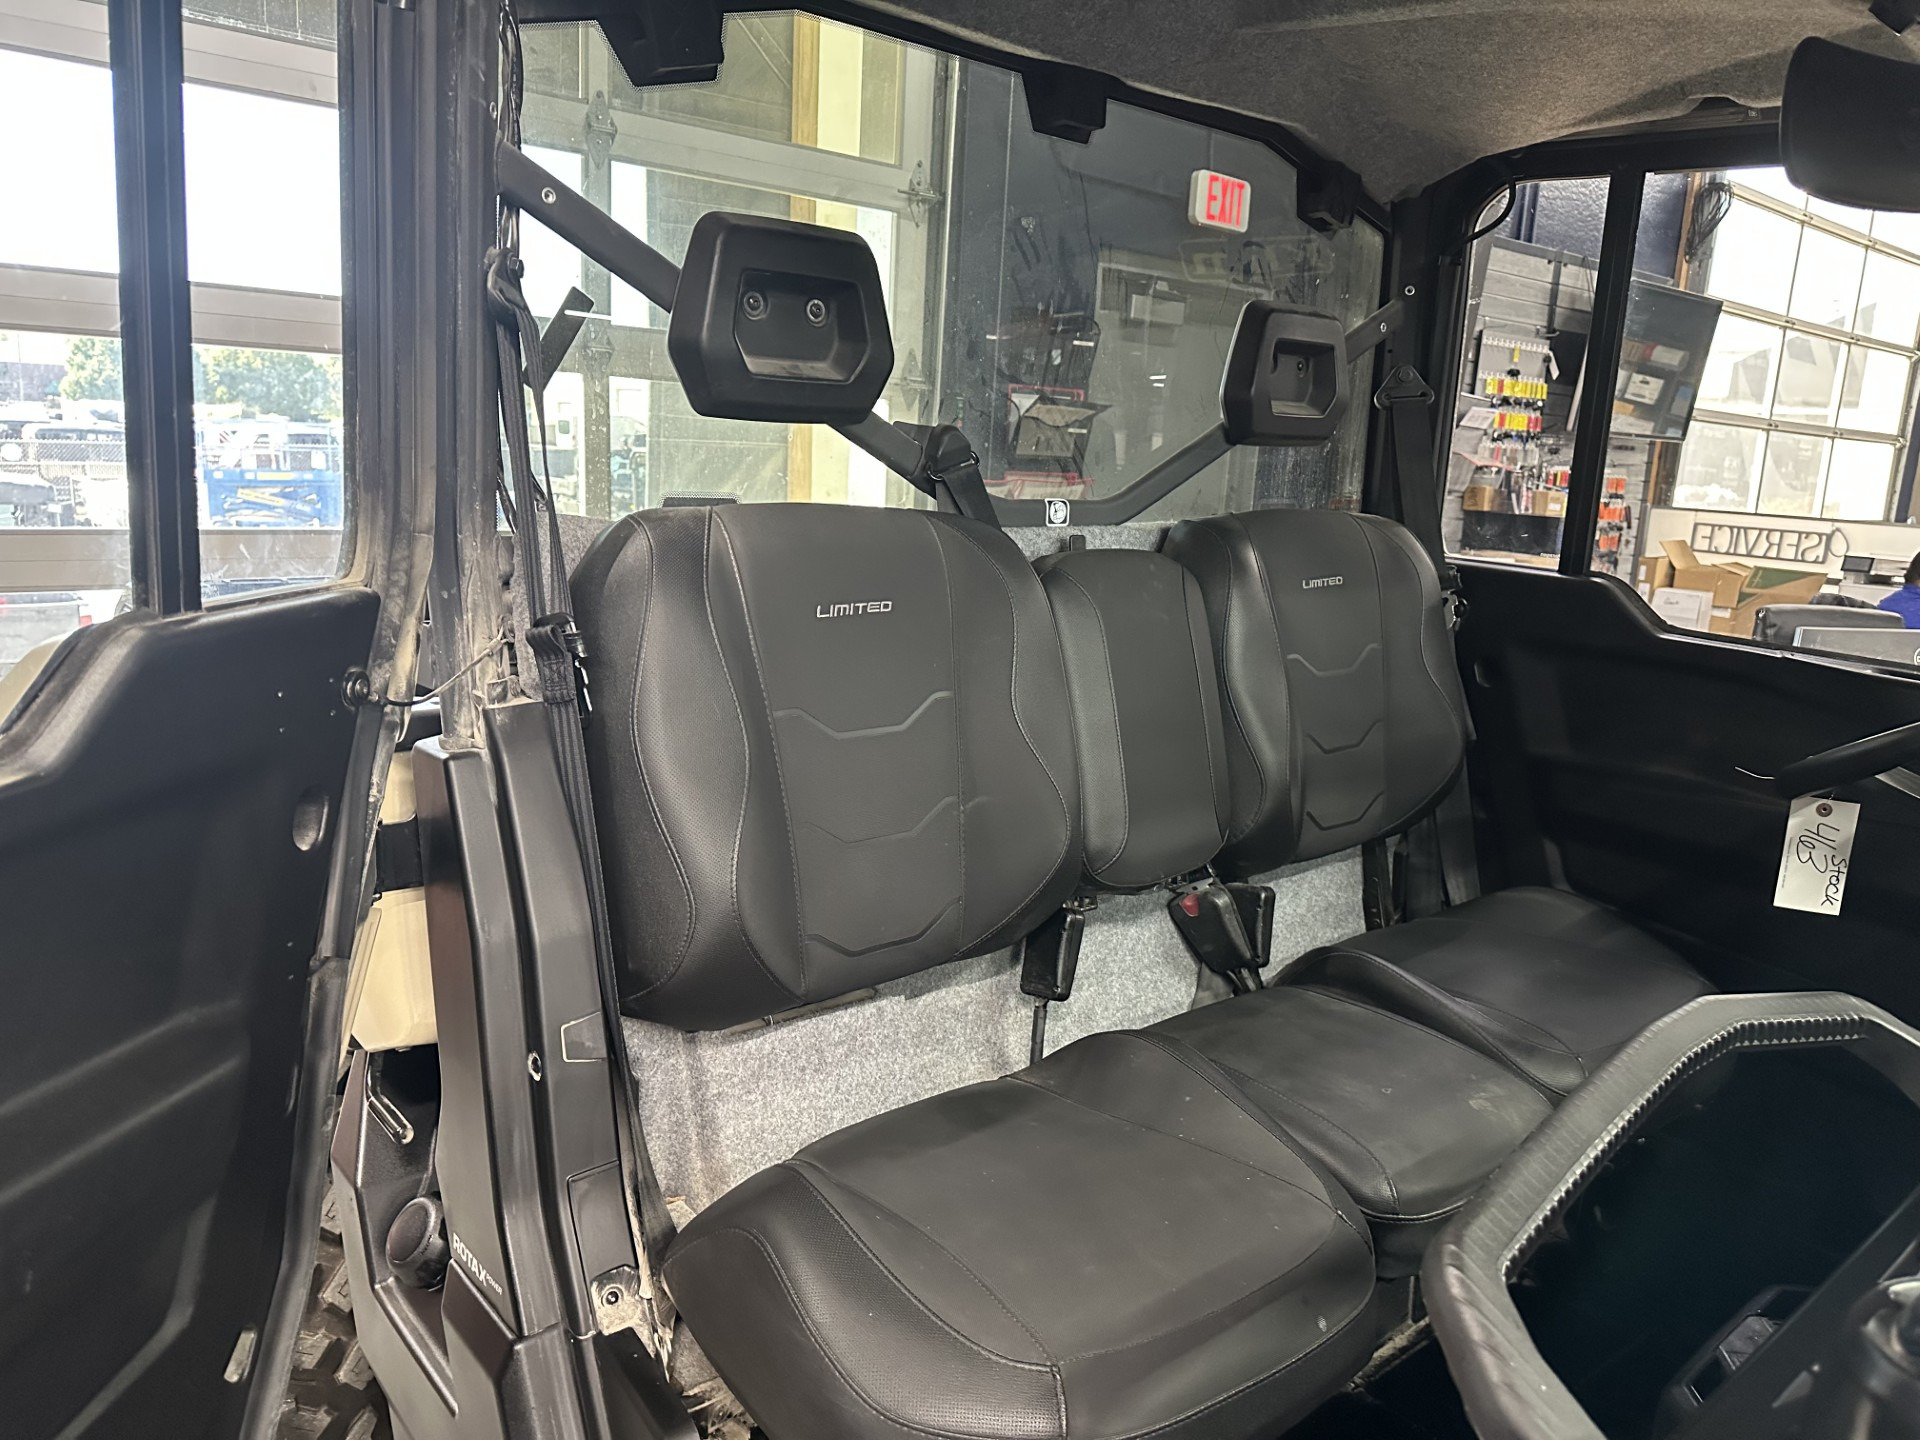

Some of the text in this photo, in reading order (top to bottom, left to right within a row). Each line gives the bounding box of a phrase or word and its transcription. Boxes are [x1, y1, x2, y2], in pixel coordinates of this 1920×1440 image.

[1205, 173, 1246, 228] EXIT
[1302, 576, 1343, 589] LIMITED
[816, 600, 893, 618] LIMITED
[1796, 822, 1841, 874] 463
[1820, 854, 1848, 907] Stock
[452, 1232, 487, 1287] ROTAX
[485, 1272, 503, 1296] POWER
